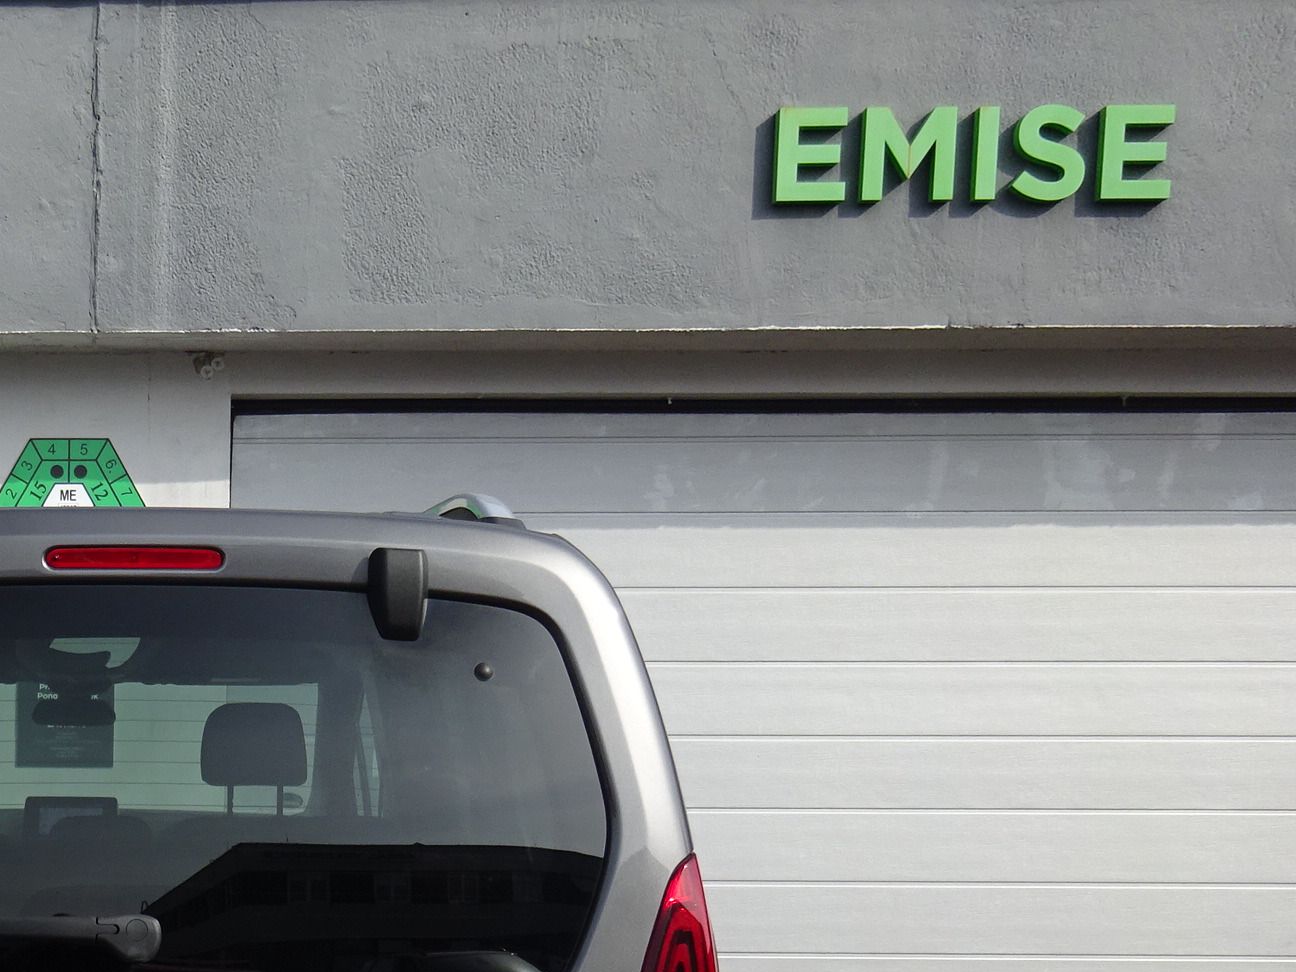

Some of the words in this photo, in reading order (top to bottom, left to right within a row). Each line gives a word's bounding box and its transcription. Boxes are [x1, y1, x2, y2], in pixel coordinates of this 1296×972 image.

[773, 104, 1176, 205] EMISE
[47, 444, 56, 455] 4
[80, 444, 88, 455] 5
[21, 460, 33, 471] 3
[5, 488, 18, 500] 2
[30, 480, 47, 501] 15
[60, 490, 77, 501] ME
[90, 482, 109, 501] 12
[120, 488, 133, 497] 7
